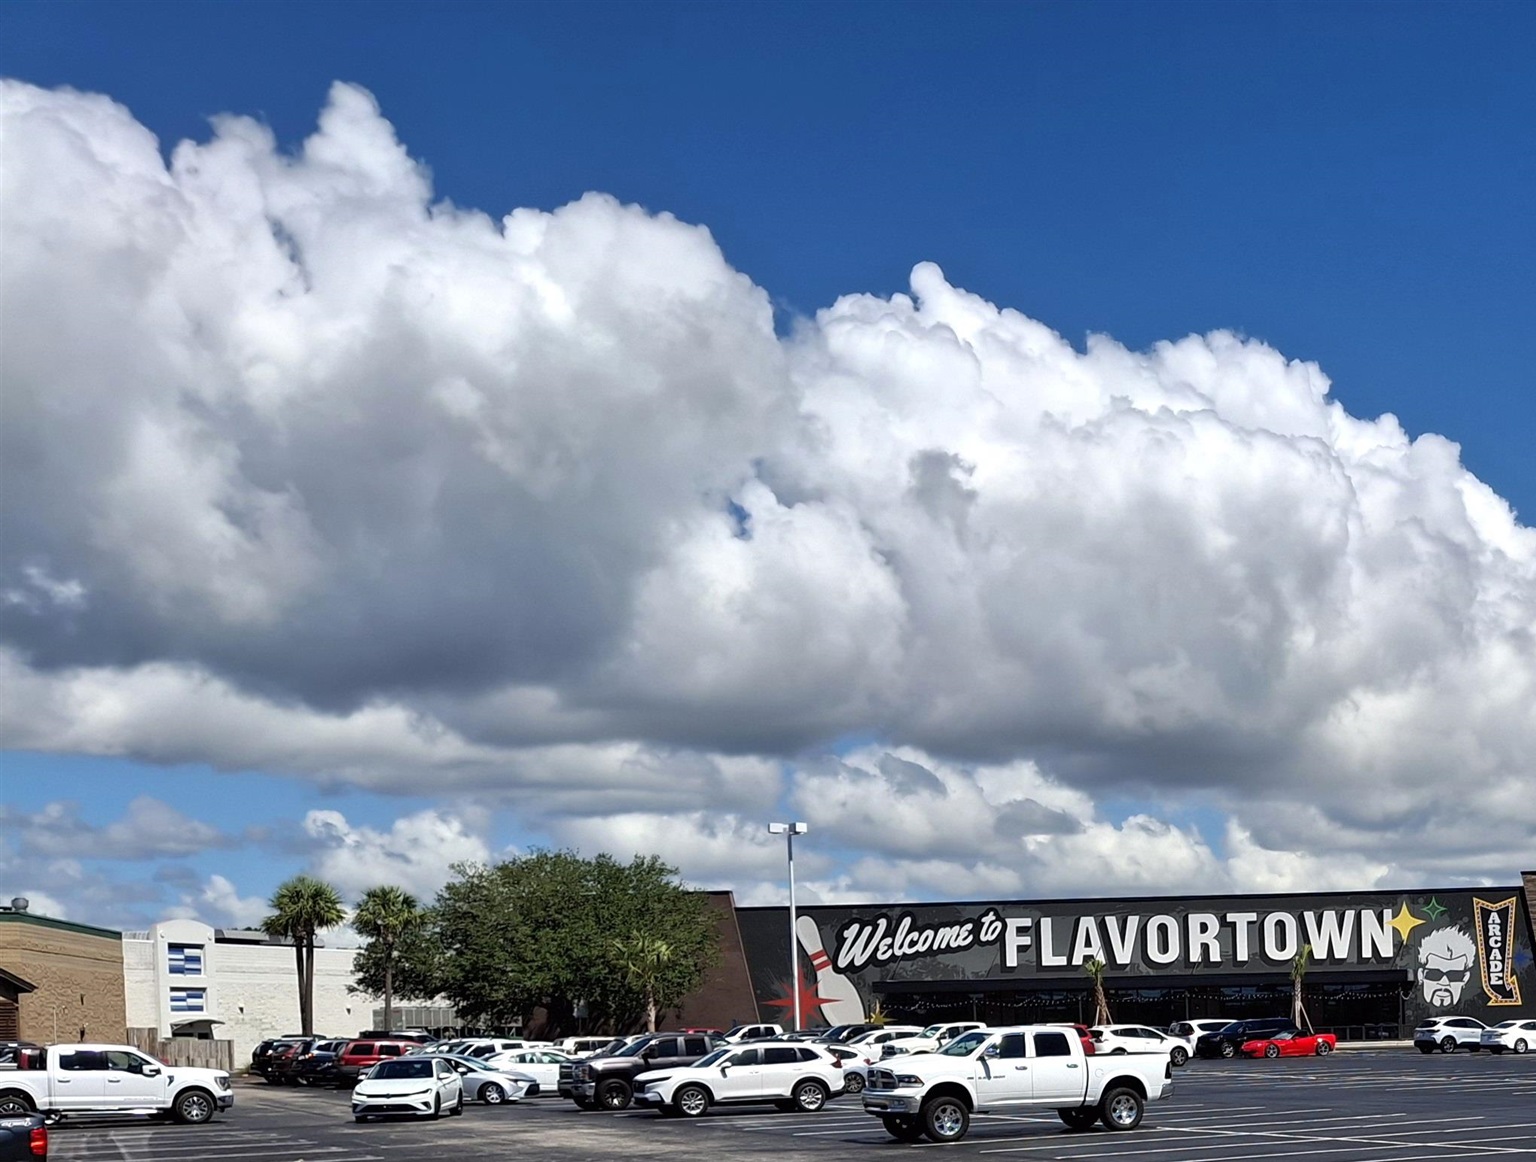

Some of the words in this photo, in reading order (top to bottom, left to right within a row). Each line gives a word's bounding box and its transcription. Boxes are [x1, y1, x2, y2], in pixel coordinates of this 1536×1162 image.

[837, 916, 973, 968] Welcome
[980, 911, 1002, 942] to
[1004, 909, 1394, 967] FLAVORTOWN
[1488, 912, 1503, 985] ARCADE
